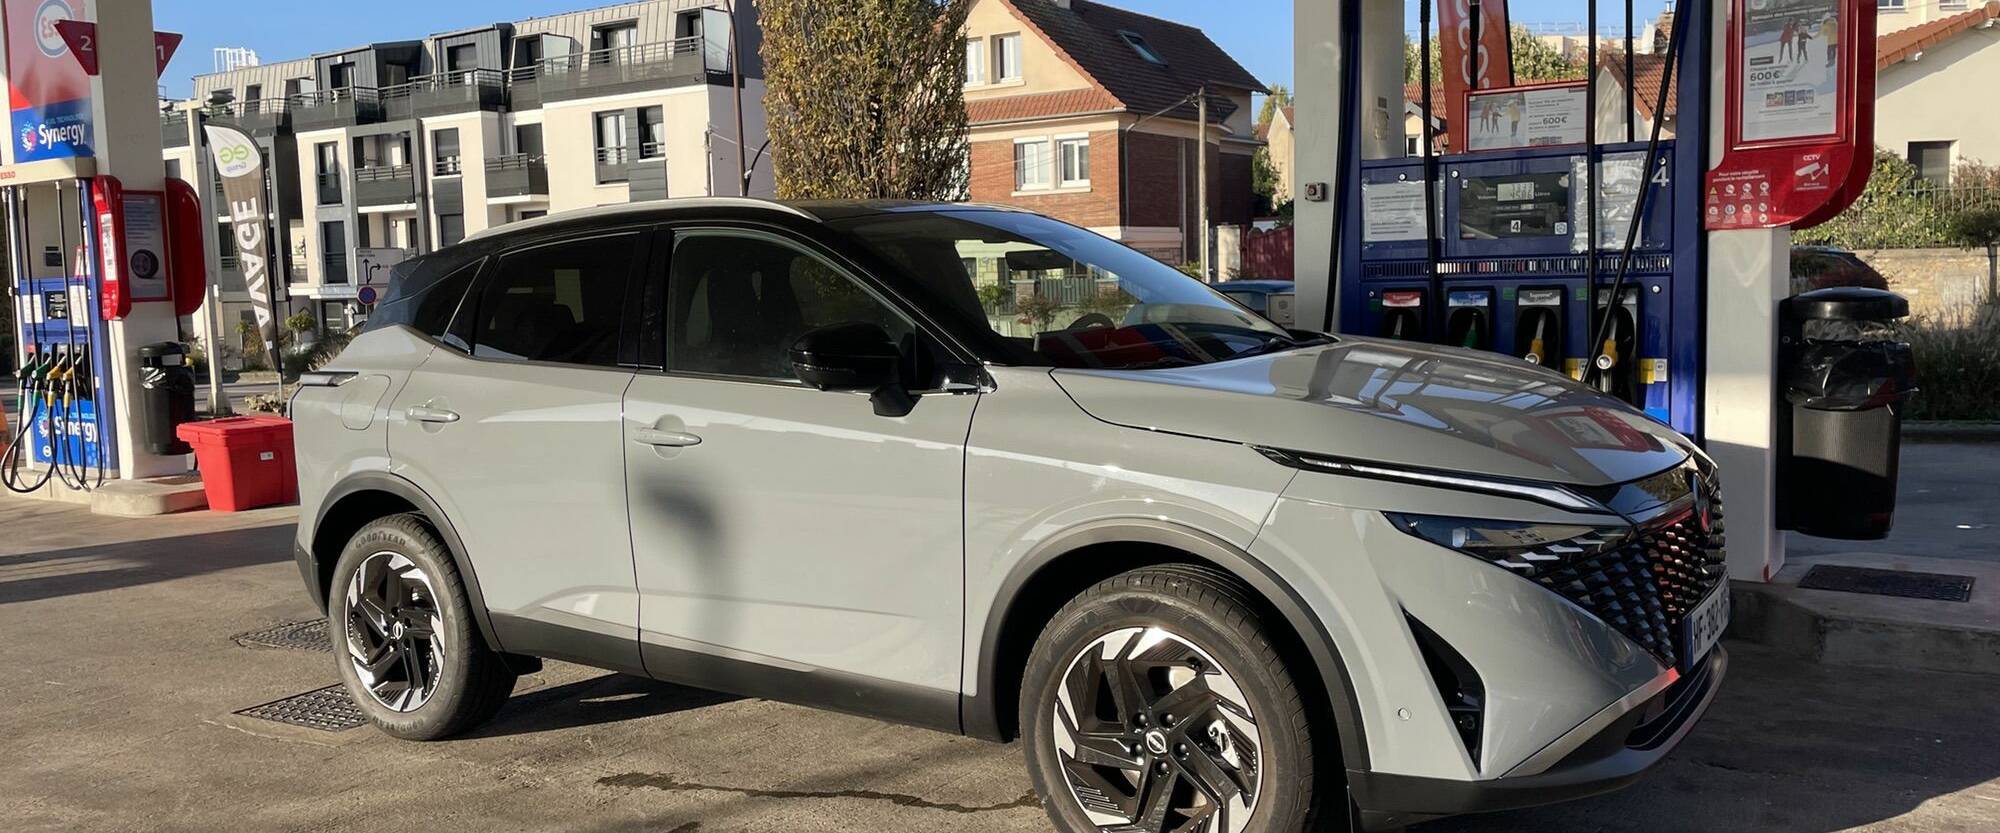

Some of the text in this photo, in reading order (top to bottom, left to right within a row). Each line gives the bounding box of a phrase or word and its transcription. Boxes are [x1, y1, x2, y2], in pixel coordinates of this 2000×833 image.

[80, 36, 93, 51] 2
[157, 45, 165, 60] 1
[38, 123, 86, 149] Synergy
[1652, 166, 1670, 187] 4
[1512, 221, 1519, 231] 4
